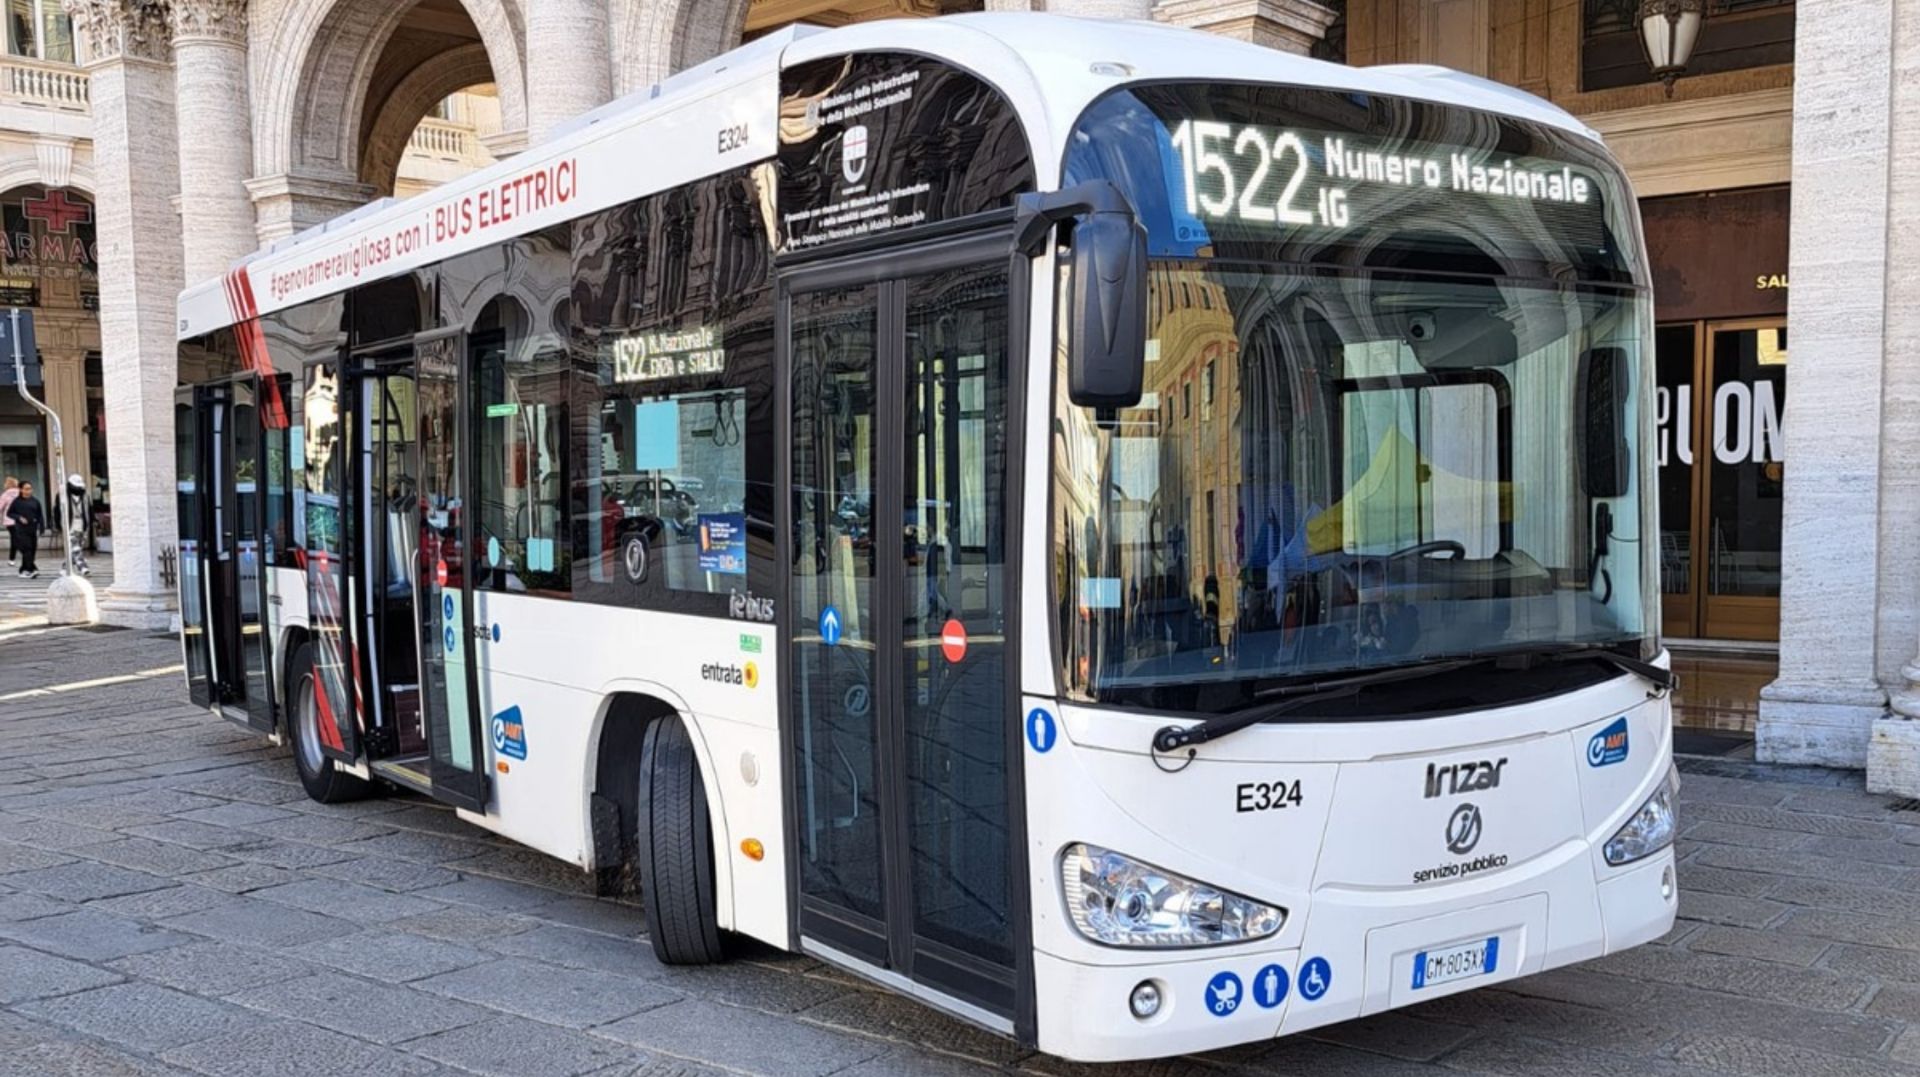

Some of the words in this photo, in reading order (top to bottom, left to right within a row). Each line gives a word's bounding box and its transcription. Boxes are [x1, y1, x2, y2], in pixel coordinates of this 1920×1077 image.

[718, 122, 749, 154] E324
[1171, 119, 1314, 226] 1522
[1324, 137, 1441, 188] Numero
[1451, 153, 1588, 204] Nazionale
[270, 234, 391, 301] #genovameravigliosa
[395, 225, 421, 256] con
[426, 213, 430, 246] i
[436, 198, 473, 243] BUS
[479, 158, 576, 229] ELETTRICI
[614, 337, 647, 383] 1522
[702, 662, 743, 685] entrata
[1236, 780, 1303, 813] E324
[1424, 758, 1508, 799] Irizar
[1413, 859, 1460, 883] servizio
[1461, 853, 1508, 877] pubblico
